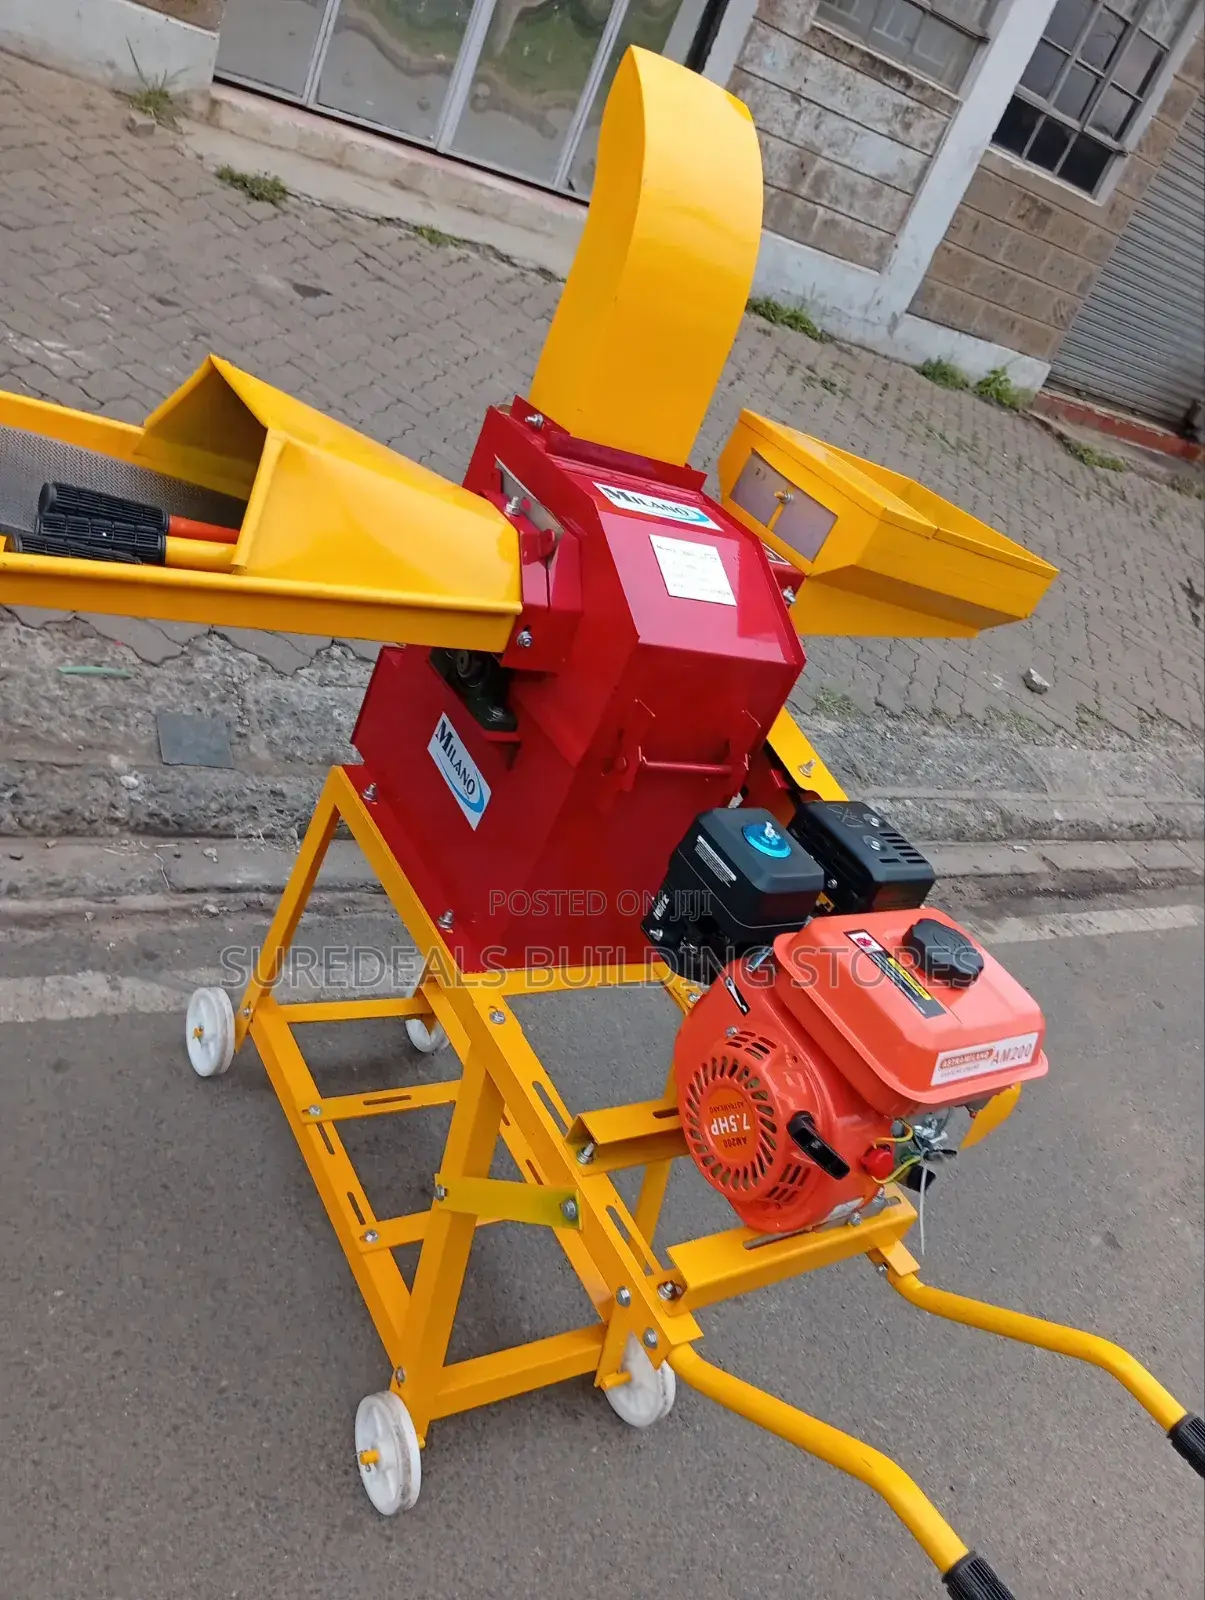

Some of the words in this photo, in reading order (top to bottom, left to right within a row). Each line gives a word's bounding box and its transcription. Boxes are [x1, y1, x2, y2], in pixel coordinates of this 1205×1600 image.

[600, 486, 690, 517] MILANO
[435, 720, 476, 796] MILANO
[990, 1043, 1032, 1066] AM200
[710, 1112, 751, 1136] 7.5HP
[722, 1136, 747, 1149] AM200
